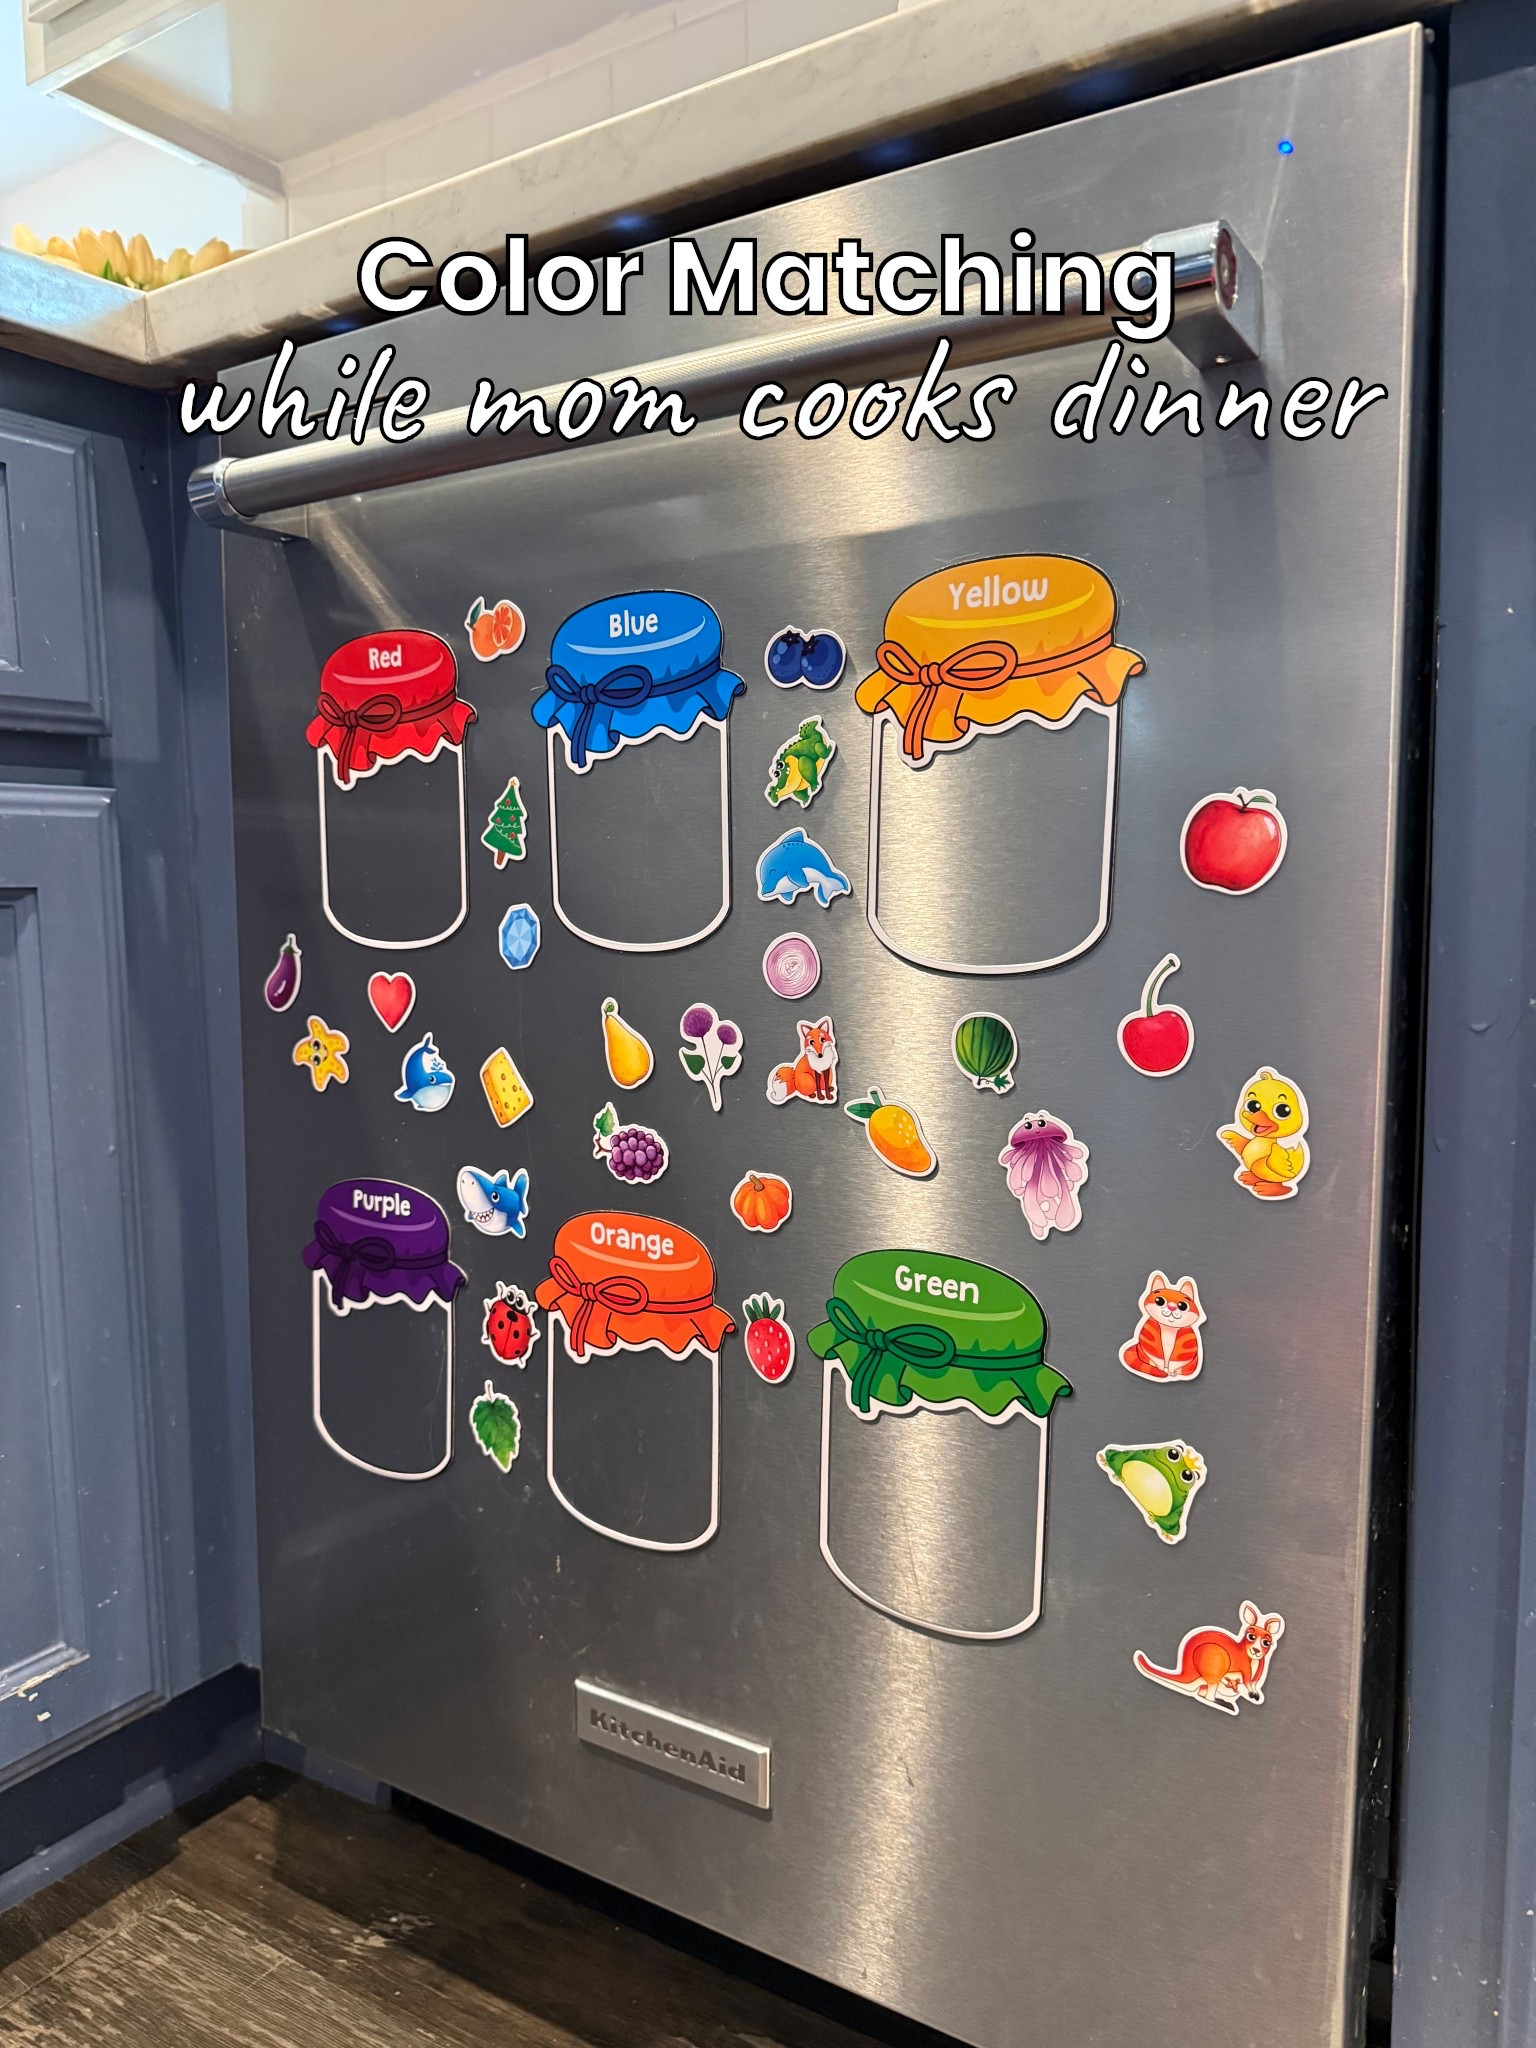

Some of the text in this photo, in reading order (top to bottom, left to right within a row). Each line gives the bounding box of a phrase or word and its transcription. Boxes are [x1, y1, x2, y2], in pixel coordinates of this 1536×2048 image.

[949, 575, 1048, 611] Yellow
[609, 611, 659, 638] Blue
[368, 644, 402, 671] Red
[352, 1189, 411, 1218] Purple
[590, 1222, 674, 1260] Orange
[895, 1265, 979, 1304] Green
[590, 1708, 746, 1785] KitchenAid
